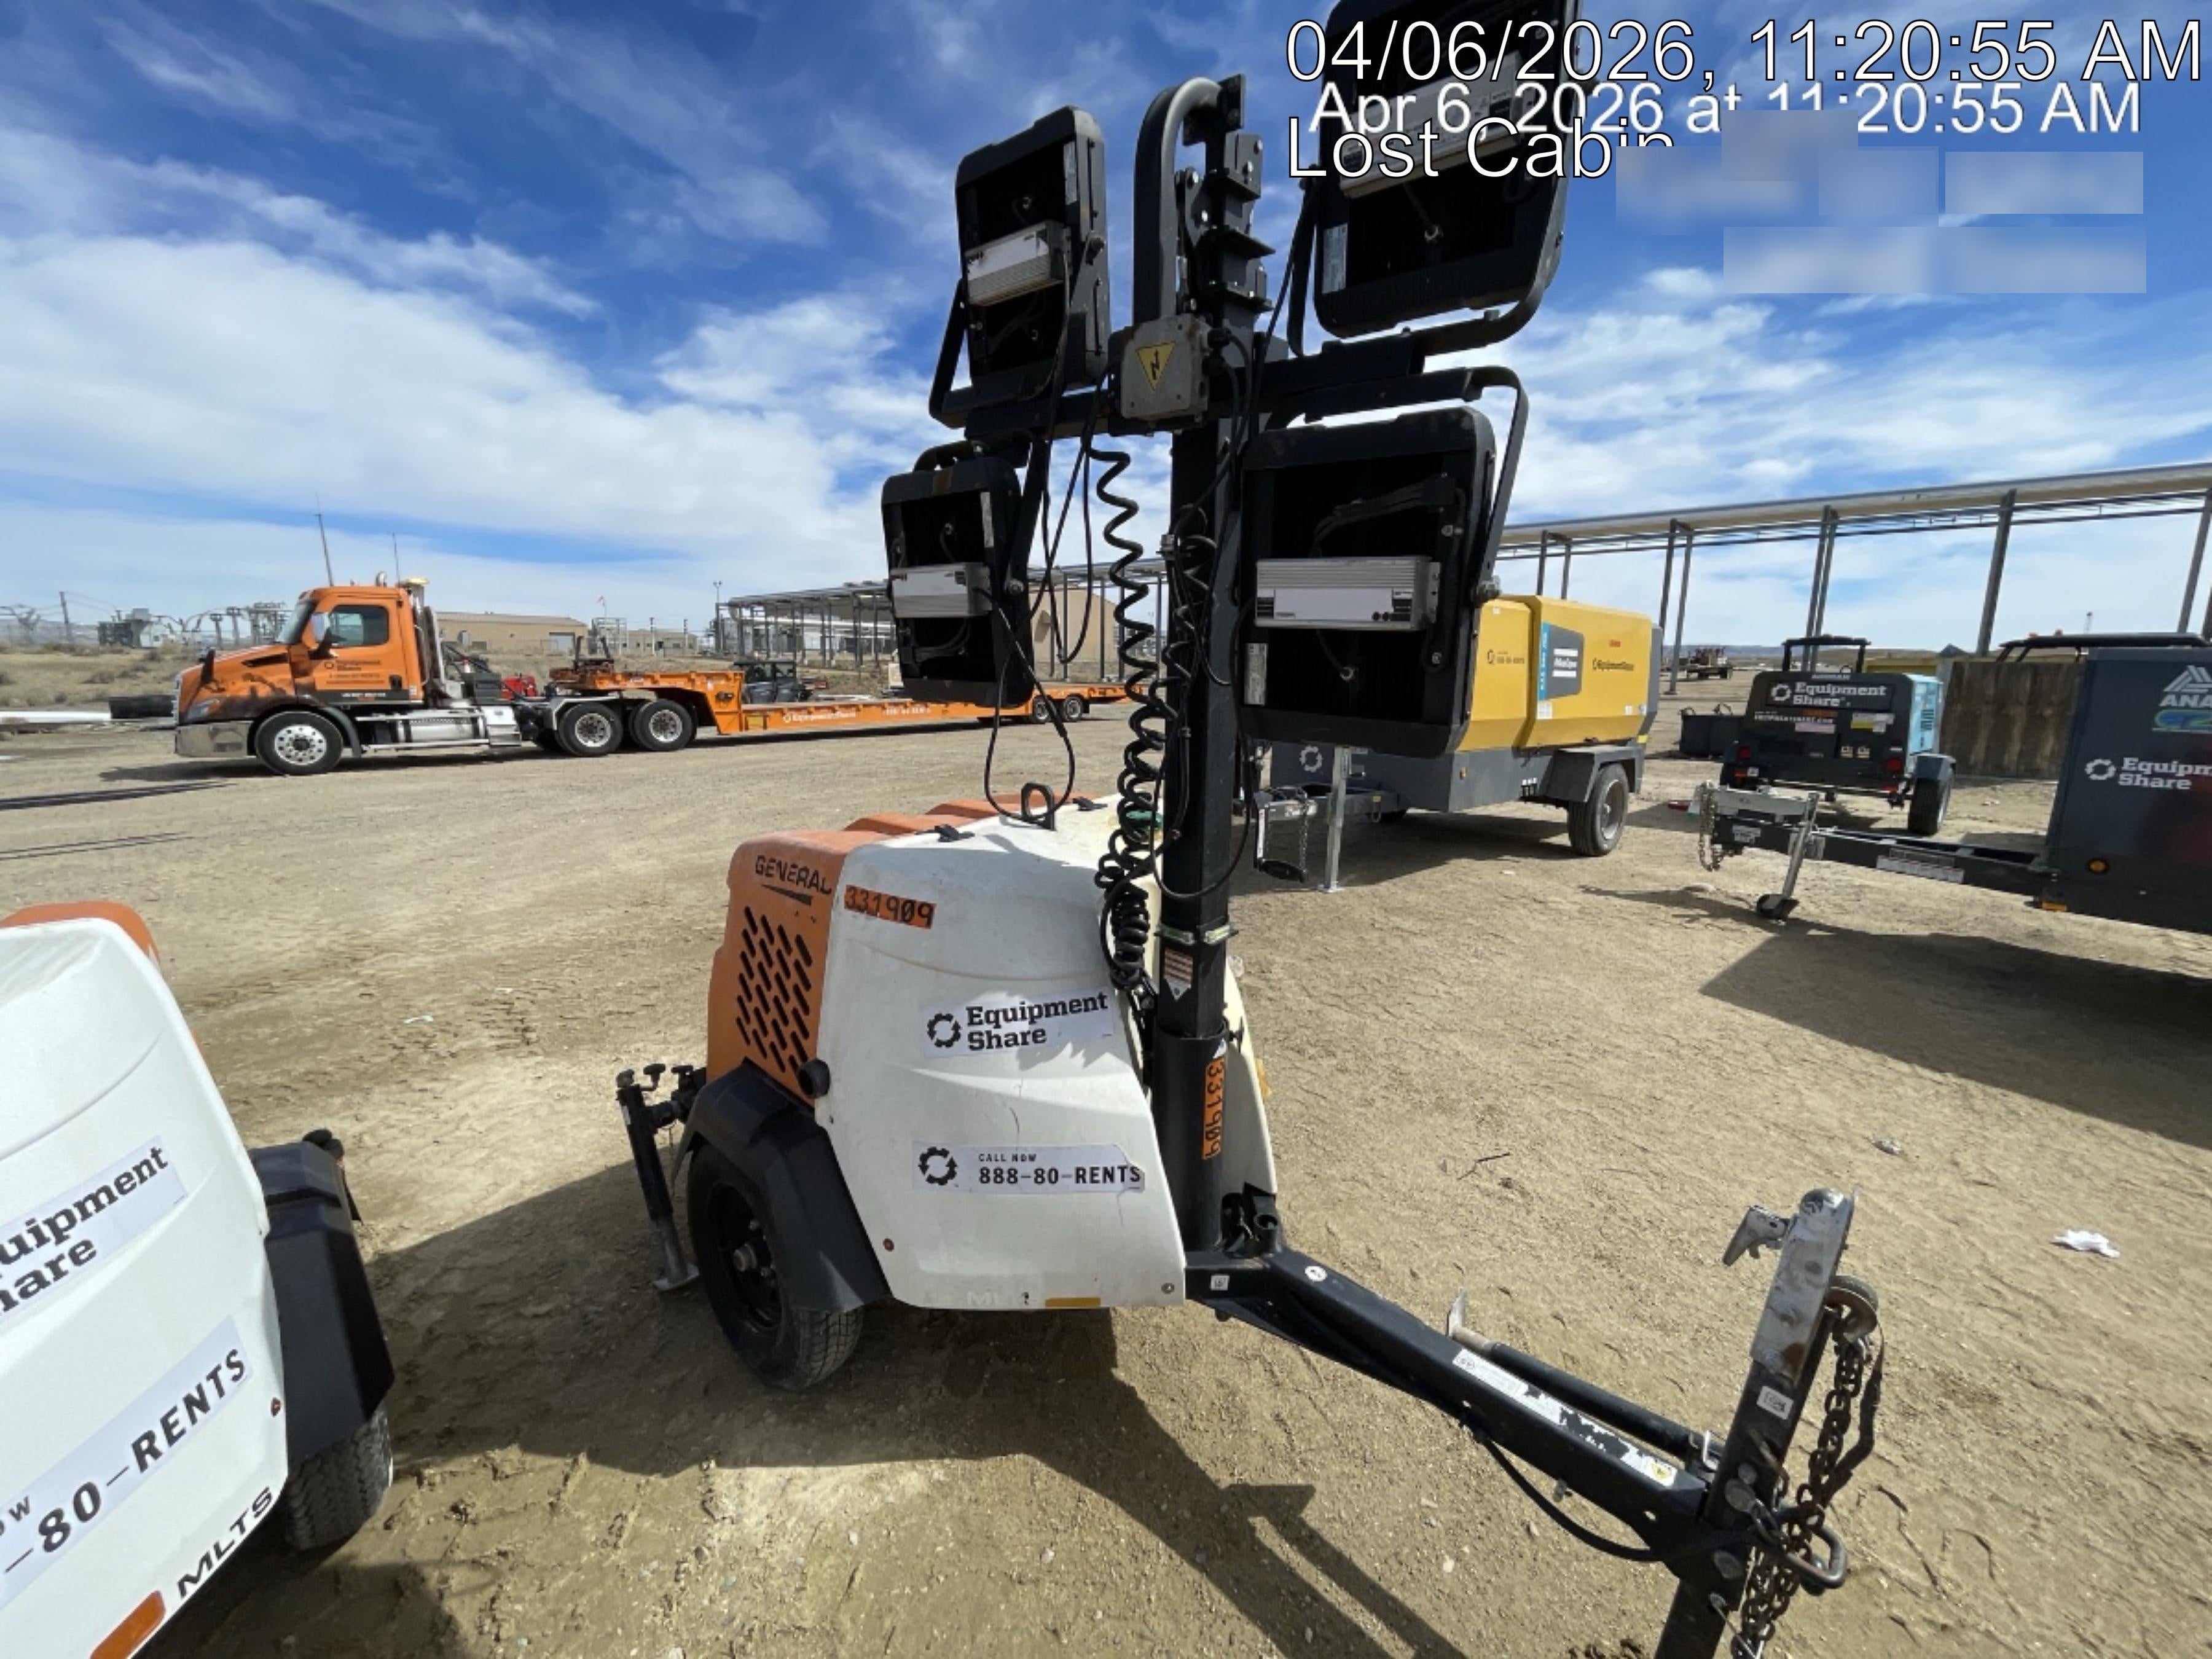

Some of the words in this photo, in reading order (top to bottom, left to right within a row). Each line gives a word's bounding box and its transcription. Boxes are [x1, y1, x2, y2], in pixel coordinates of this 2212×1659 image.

[1793, 694, 1841, 707] Share
[1795, 681, 1887, 696] Equipment
[2117, 772, 2193, 790] Share
[755, 855, 832, 895] GENERAL
[845, 885, 935, 927] 331909
[965, 991, 1108, 1029] Equipment
[967, 1027, 1047, 1051] Share
[1205, 1064, 1224, 1159] 331909
[978, 1153, 1006, 1163] CALL
[1011, 1153, 1037, 1163] NOW
[978, 1165, 1142, 1185] 888-80-RENTS
[0, 1145, 168, 1278] uipment
[176, 1486, 273, 1599] MLTS
